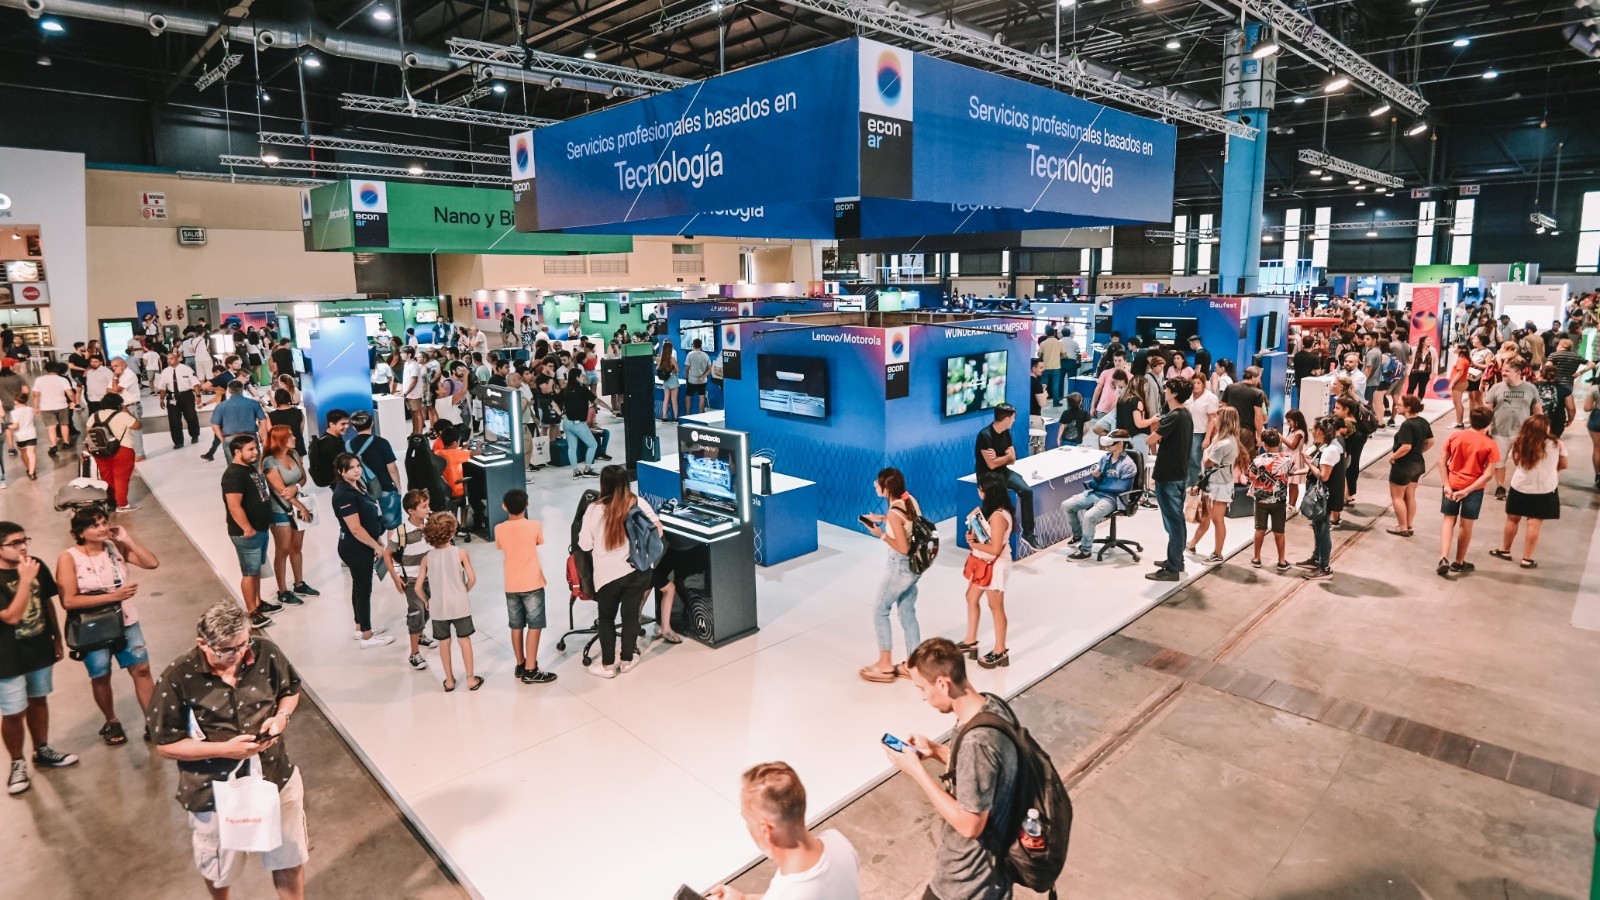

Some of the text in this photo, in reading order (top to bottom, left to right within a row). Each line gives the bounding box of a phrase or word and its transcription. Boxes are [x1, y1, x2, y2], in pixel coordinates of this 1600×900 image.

[1229, 100, 1252, 109] Salda
[567, 91, 797, 160] Servicios profesionales basados en
[867, 118, 902, 137] econ
[968, 95, 1153, 156] Servicios profesionales basados en
[867, 134, 883, 148] ar
[614, 144, 723, 191] Tecnología
[1026, 143, 1113, 194] Tecnología
[513, 182, 530, 192] econ
[514, 193, 522, 202] ar
[835, 203, 854, 211] econ
[433, 206, 481, 224] Nano
[485, 214, 495, 228] y
[910, 255, 916, 266] 7
[1210, 301, 1238, 309] Baufest
[944, 321, 1029, 339] WUNDERMAN THOMPSON
[812, 331, 881, 346] Lenovo/Motorola
[723, 350, 737, 358] econ
[887, 364, 904, 373] econ
[887, 372, 896, 380] ar
